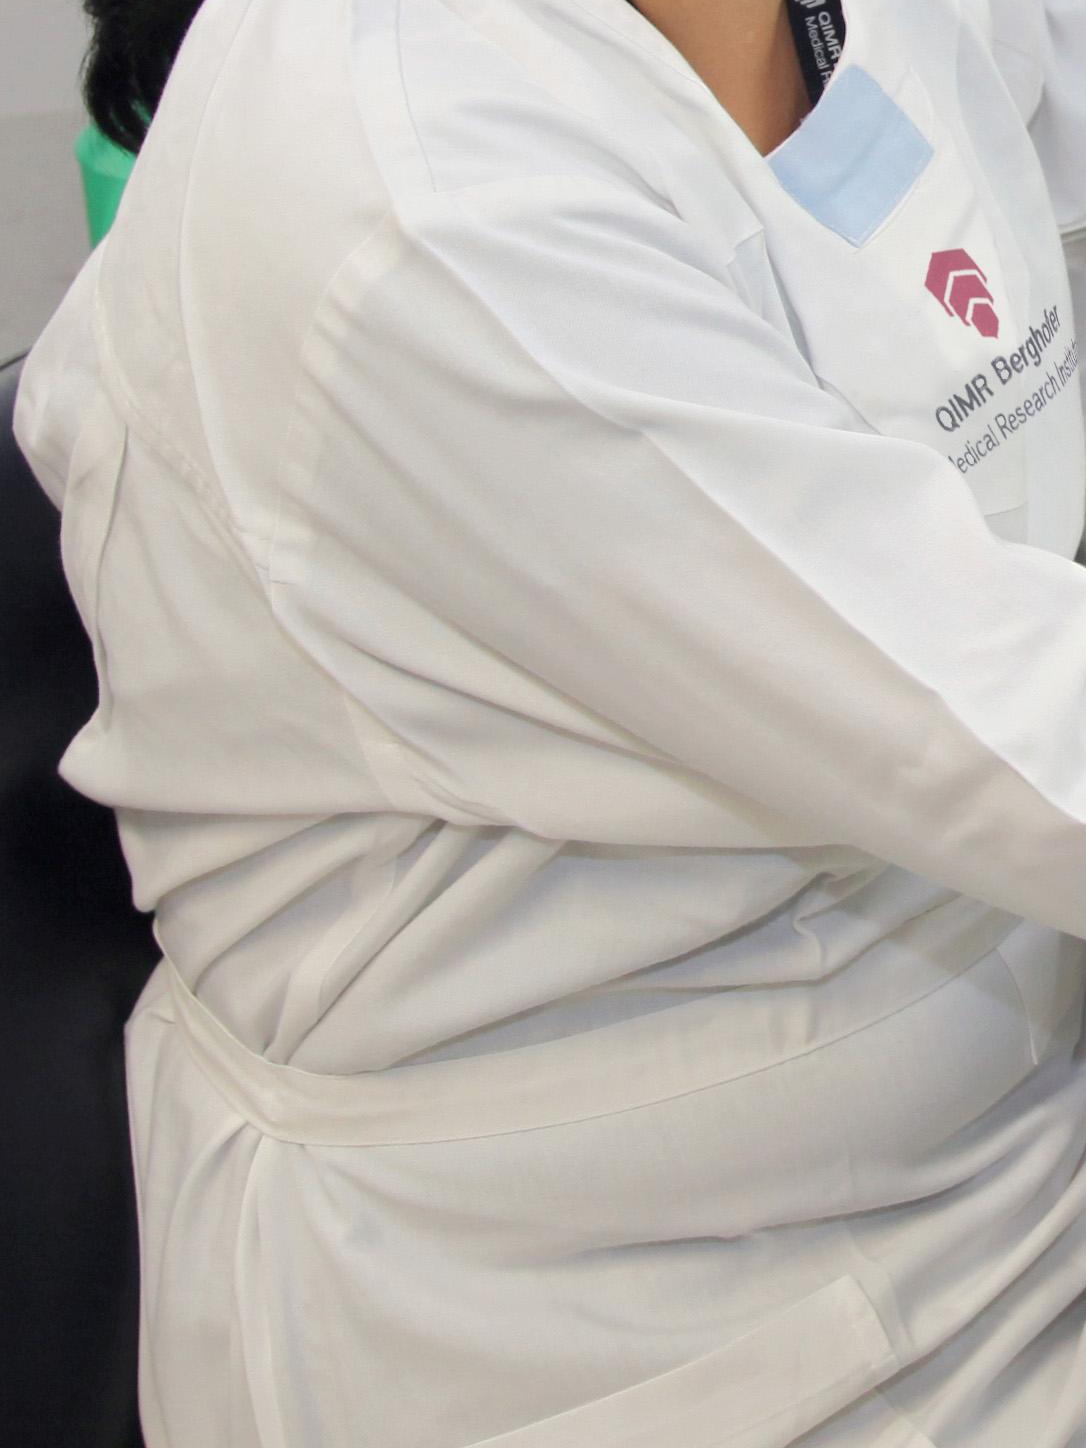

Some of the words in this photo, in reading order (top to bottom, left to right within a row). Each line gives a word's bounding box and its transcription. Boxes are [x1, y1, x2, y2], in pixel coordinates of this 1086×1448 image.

[805, 16, 830, 69] Medical
[819, 11, 842, 58] QIMR
[935, 373, 995, 433] QIMR
[990, 305, 1061, 385] Berghofer
[948, 424, 1000, 474] edical
[994, 372, 1061, 440] Research
